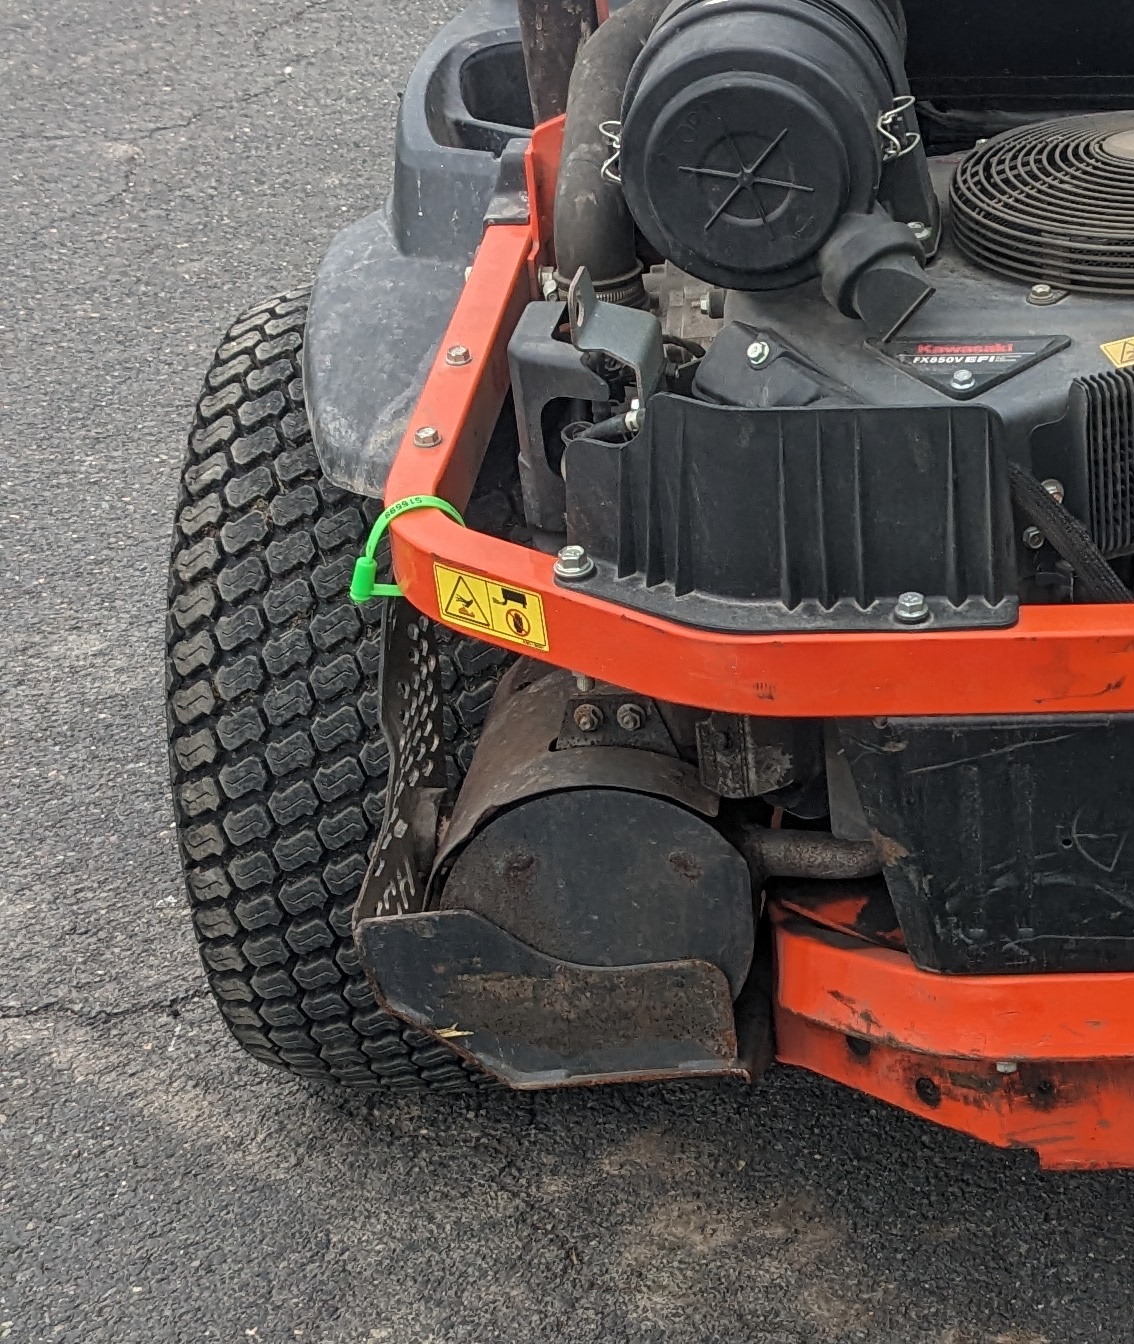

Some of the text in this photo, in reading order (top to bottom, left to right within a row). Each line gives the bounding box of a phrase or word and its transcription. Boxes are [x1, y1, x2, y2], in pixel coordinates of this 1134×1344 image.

[917, 343, 1014, 353] Kawasaki
[912, 356, 964, 364] FX850V
[964, 355, 995, 363] EFI
